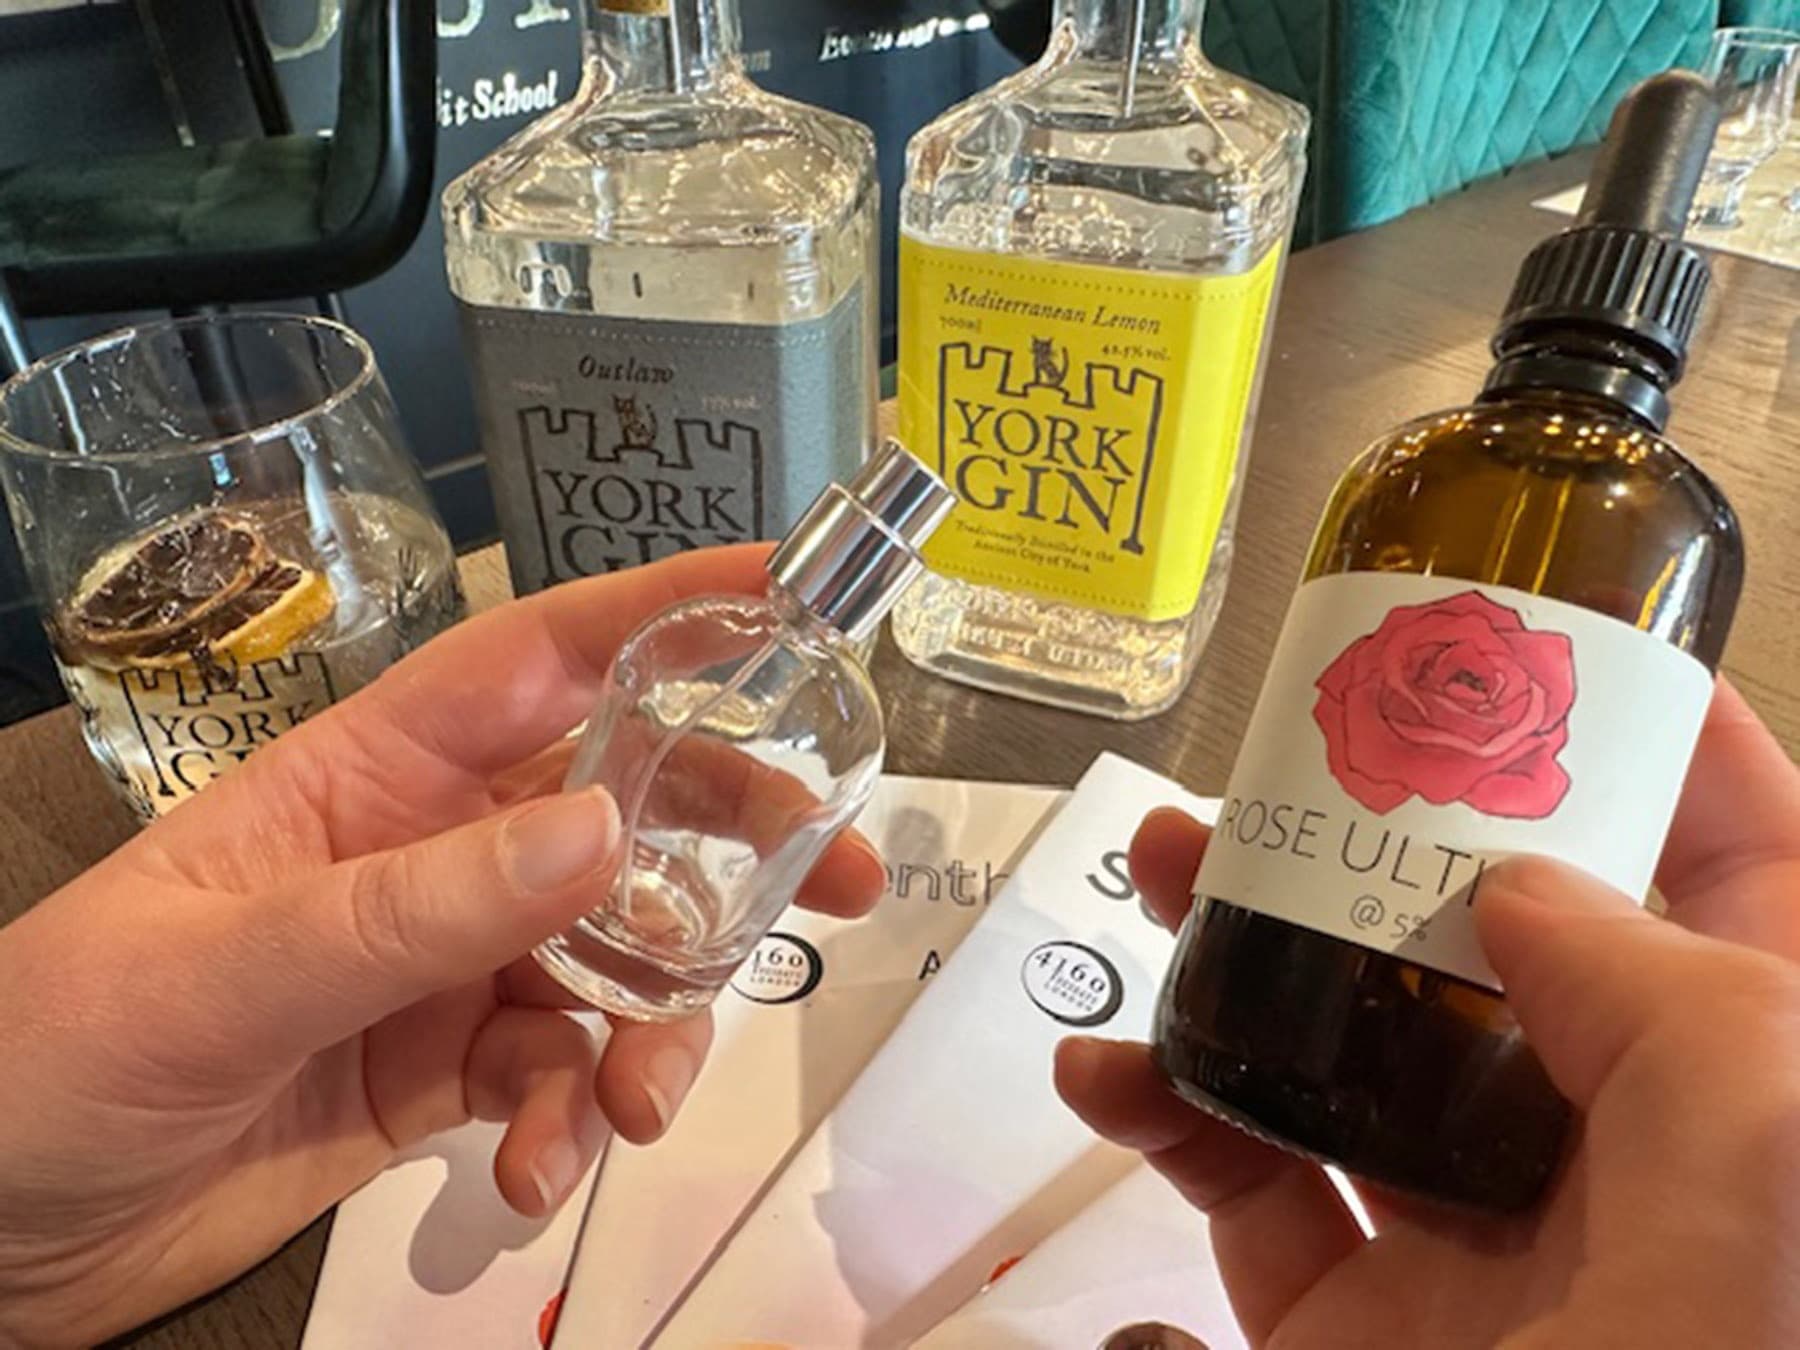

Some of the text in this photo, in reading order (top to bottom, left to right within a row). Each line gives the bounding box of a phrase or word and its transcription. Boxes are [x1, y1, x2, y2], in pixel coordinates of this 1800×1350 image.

[471, 69, 558, 119] School
[944, 284, 1161, 335] Mediterranean Lemon
[578, 354, 675, 384] Outlaw
[953, 398, 1135, 477] YORK
[543, 469, 747, 533] YORK
[954, 453, 1127, 534] GIN
[1220, 797, 1487, 907] ROSE ULTI
[1035, 950, 1106, 994] 4160
